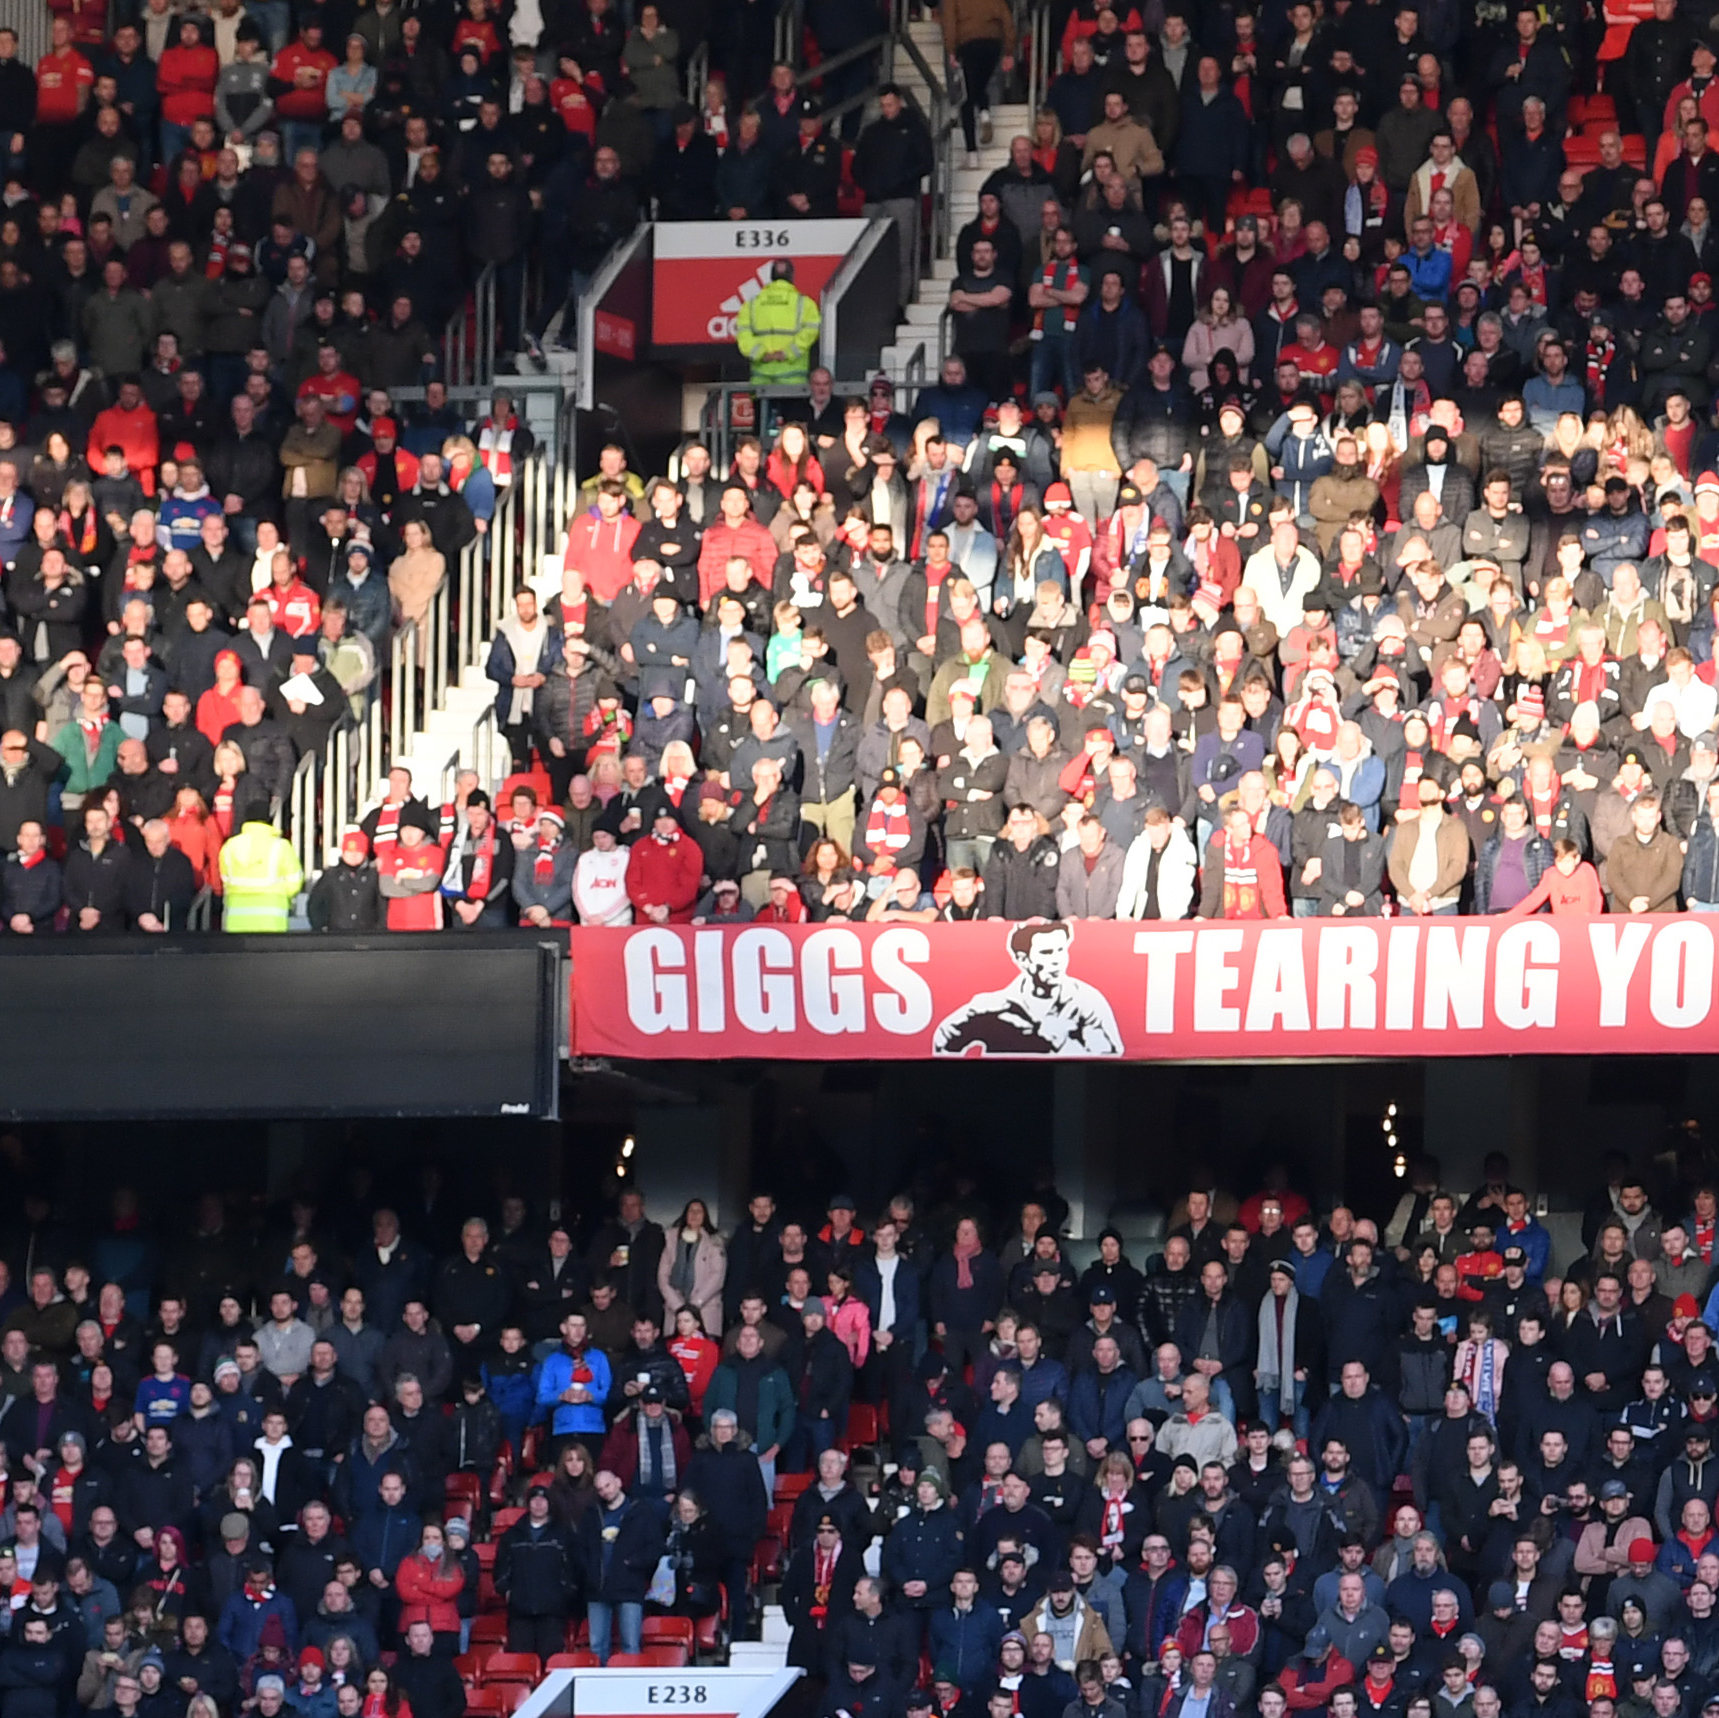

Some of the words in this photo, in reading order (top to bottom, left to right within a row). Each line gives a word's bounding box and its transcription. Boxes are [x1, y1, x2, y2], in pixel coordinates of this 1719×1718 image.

[736, 230, 789, 248] E336
[624, 927, 932, 1036] GIGGS
[1134, 921, 1560, 1034] TEARING
[648, 1685, 707, 1704] E238
